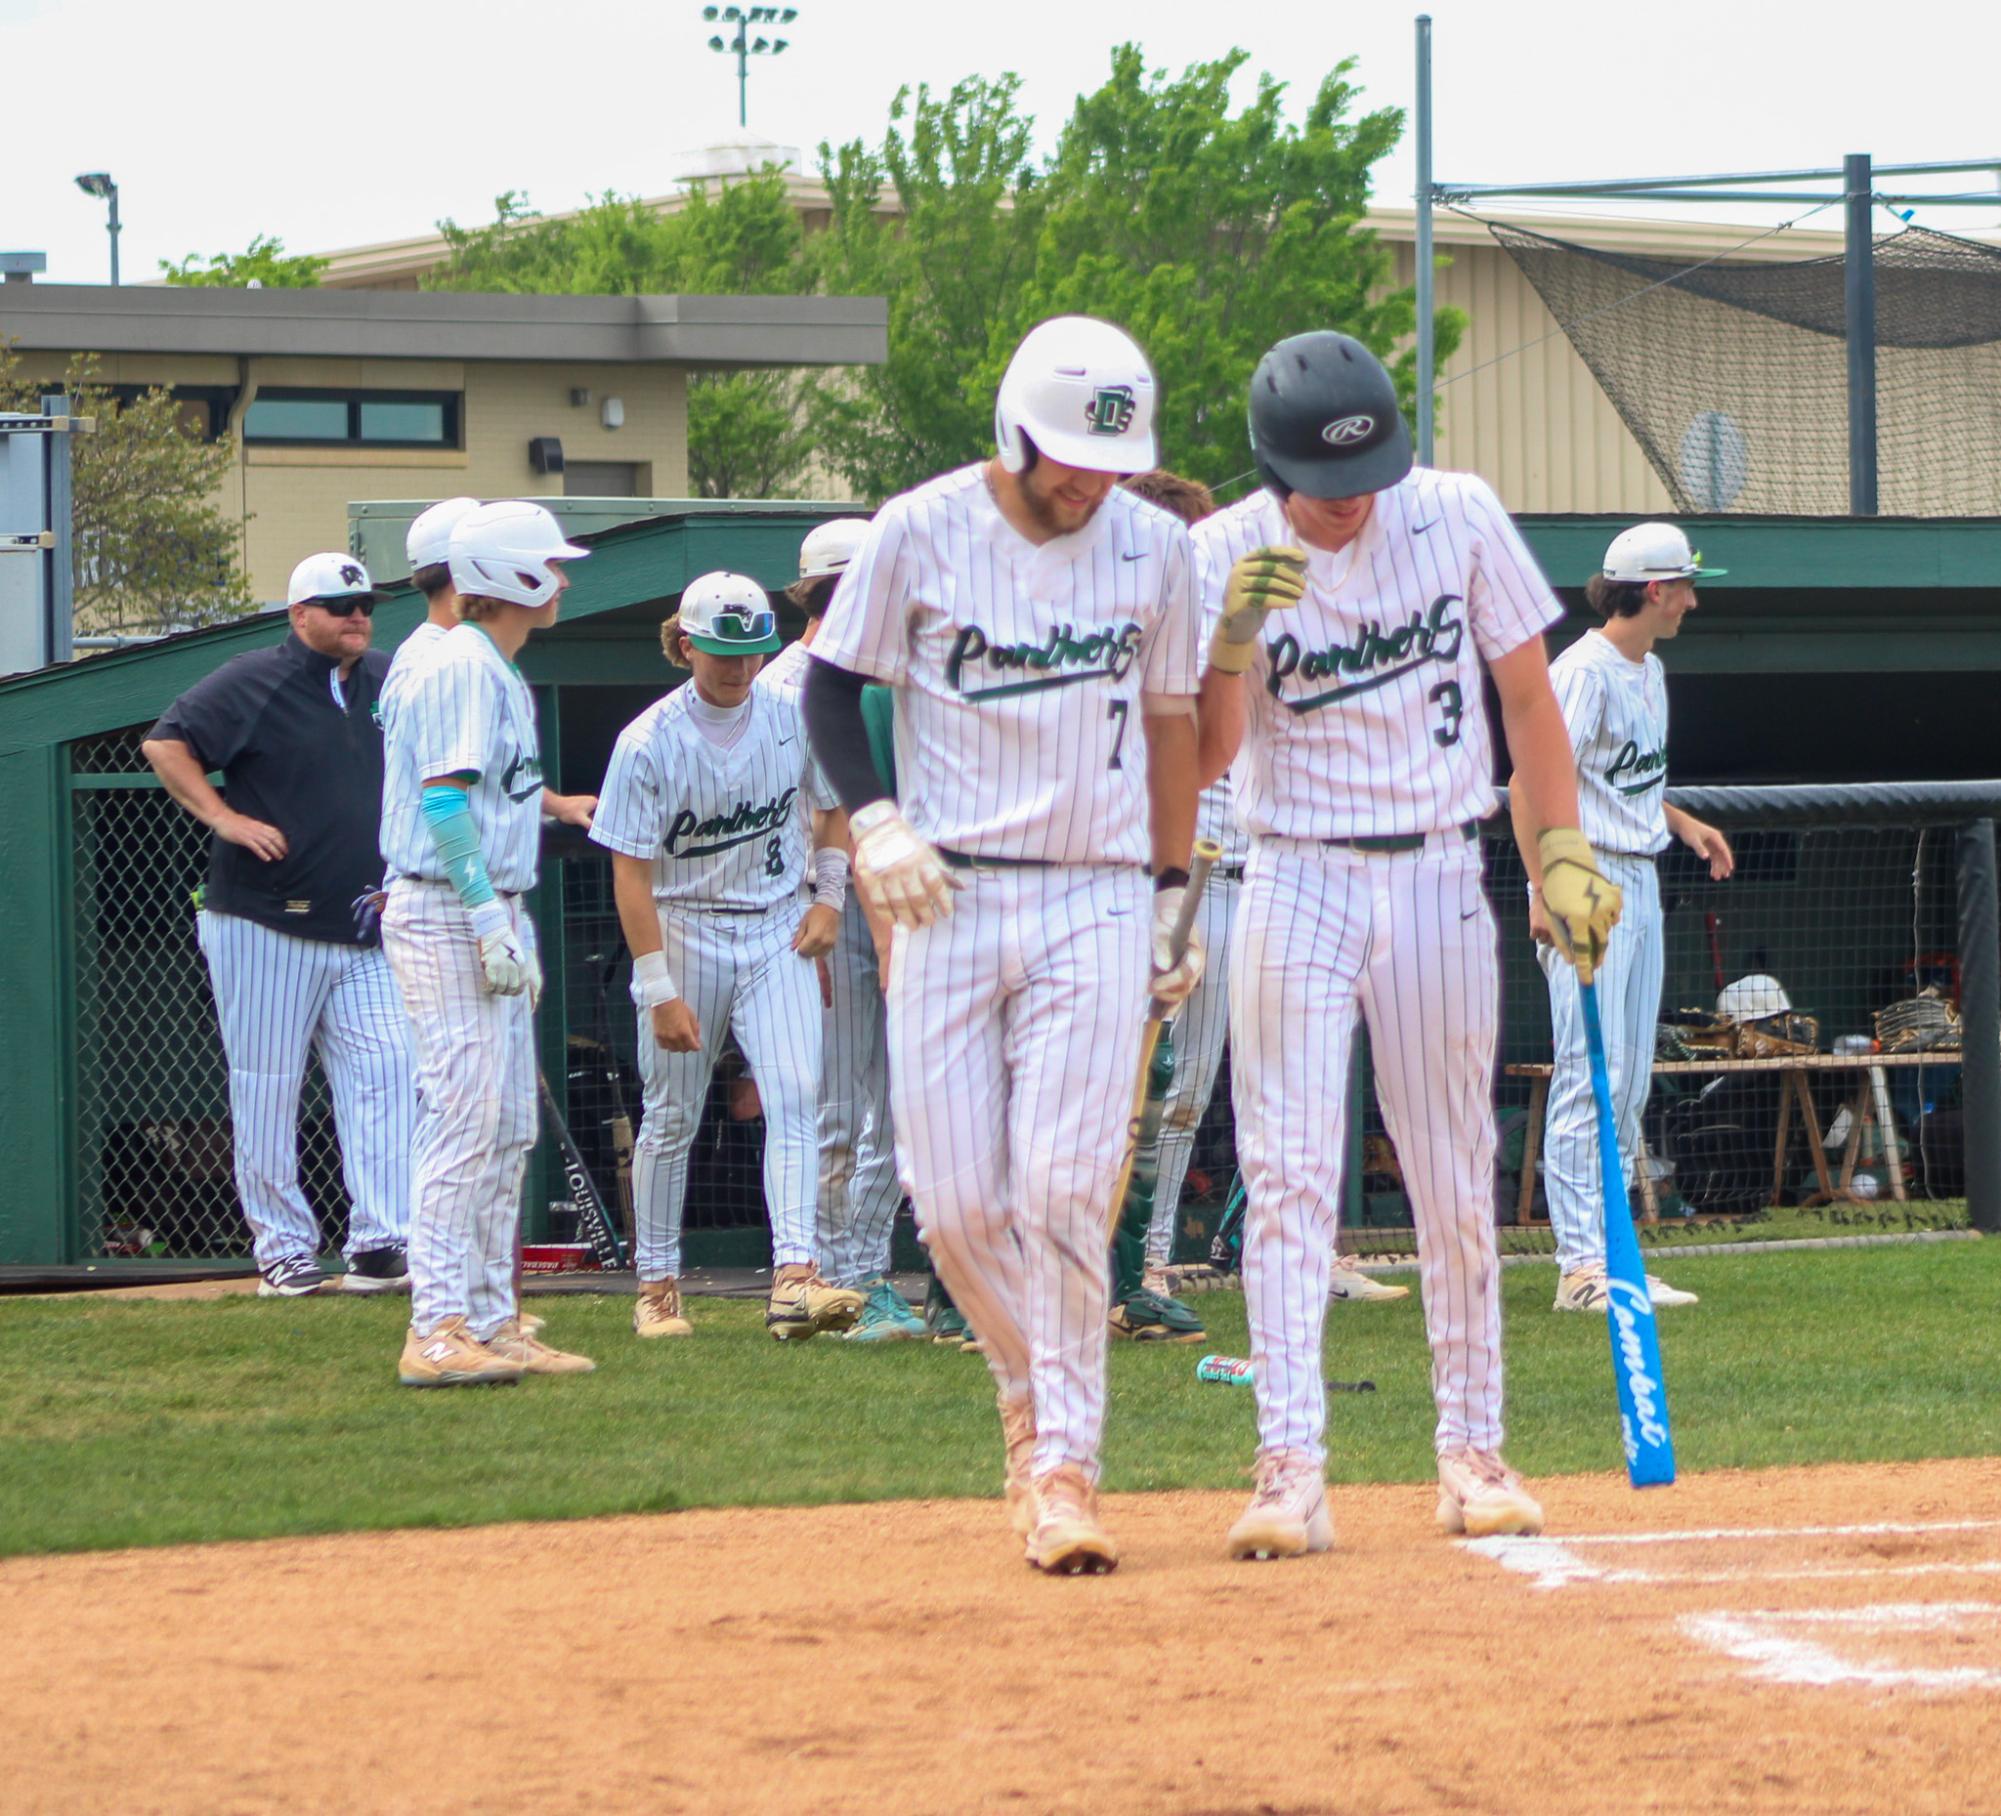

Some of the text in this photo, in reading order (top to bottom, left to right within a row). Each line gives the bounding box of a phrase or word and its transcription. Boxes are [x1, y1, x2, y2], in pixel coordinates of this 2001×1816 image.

[944, 623, 1142, 692] Panthers
[1266, 594, 1463, 701] Panthers
[1107, 700, 1128, 770] 7
[1428, 680, 1463, 748] 3
[662, 786, 798, 856] Panthers
[765, 834, 785, 878] 8
[563, 1163, 617, 1270] LOUISVILLE
[1606, 1278, 1667, 1448] Combat
